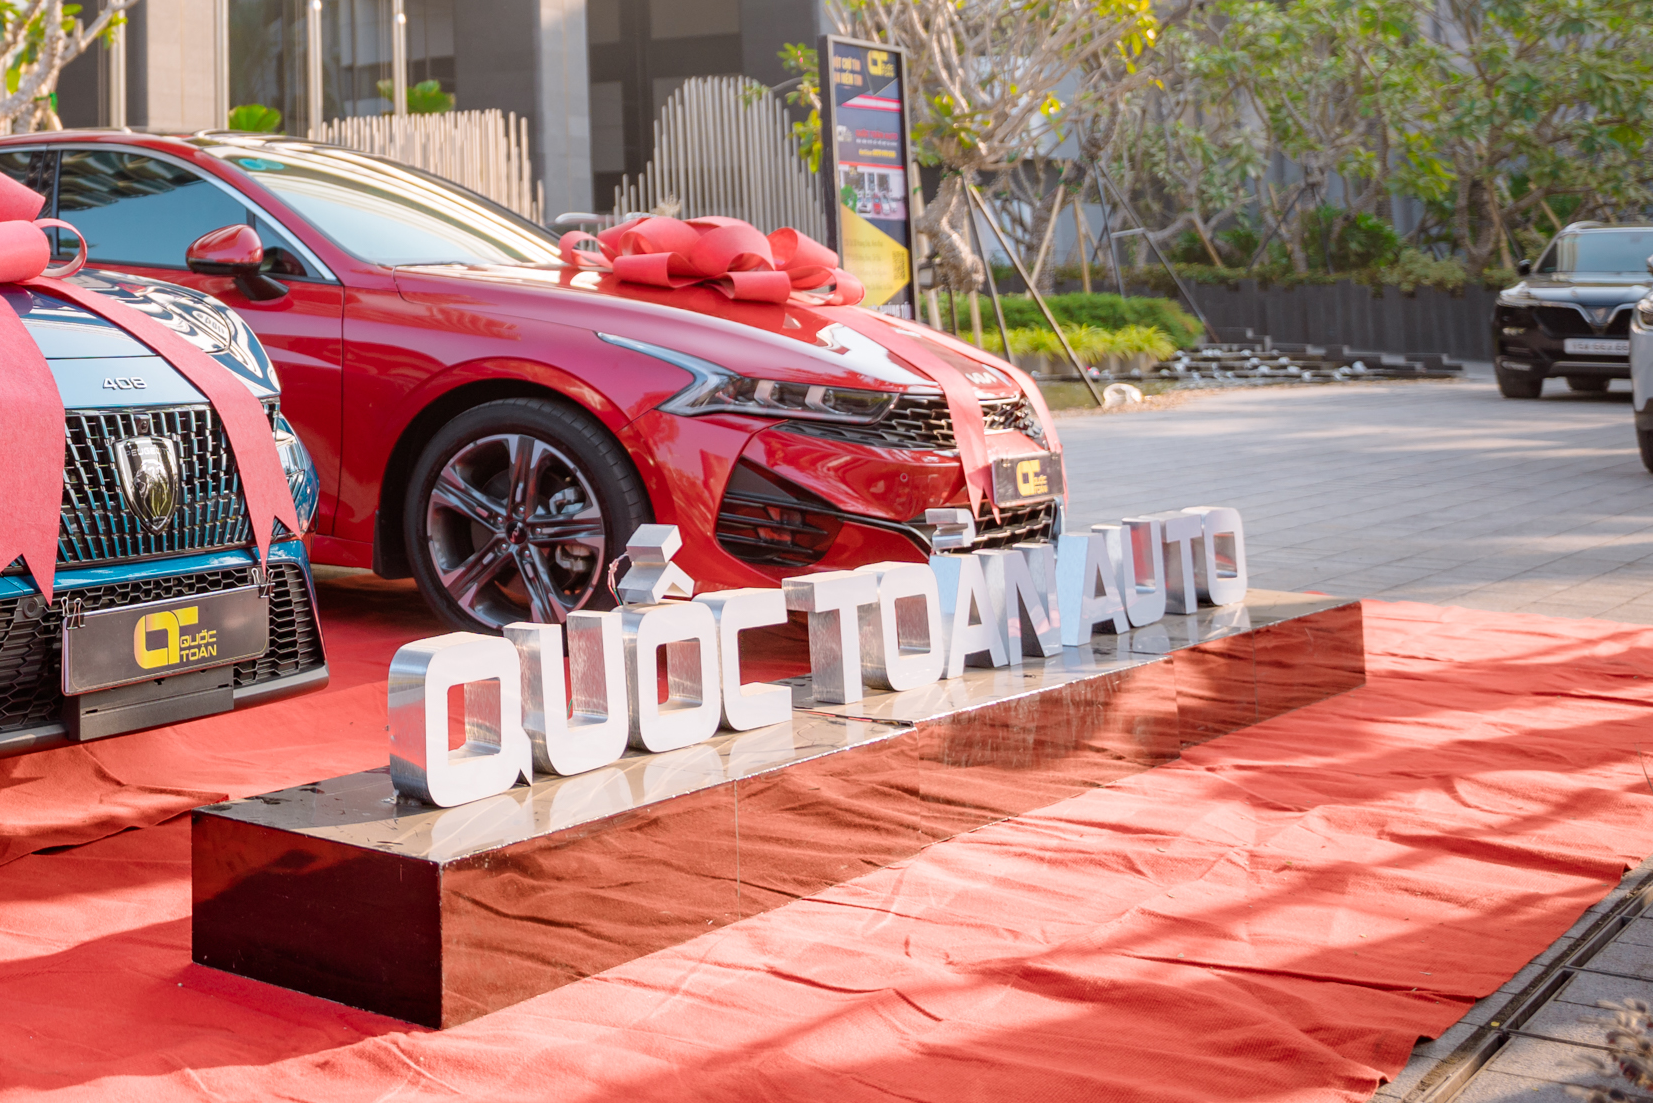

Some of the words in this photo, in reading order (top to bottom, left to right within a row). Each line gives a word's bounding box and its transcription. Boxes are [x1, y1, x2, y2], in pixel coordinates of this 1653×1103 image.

[103, 376, 147, 390] 408
[180, 629, 217, 648] QUỐC
[389, 524, 792, 807] QUỐC
[782, 508, 1063, 705] TOẢN
[1057, 506, 1247, 646] AUTO
